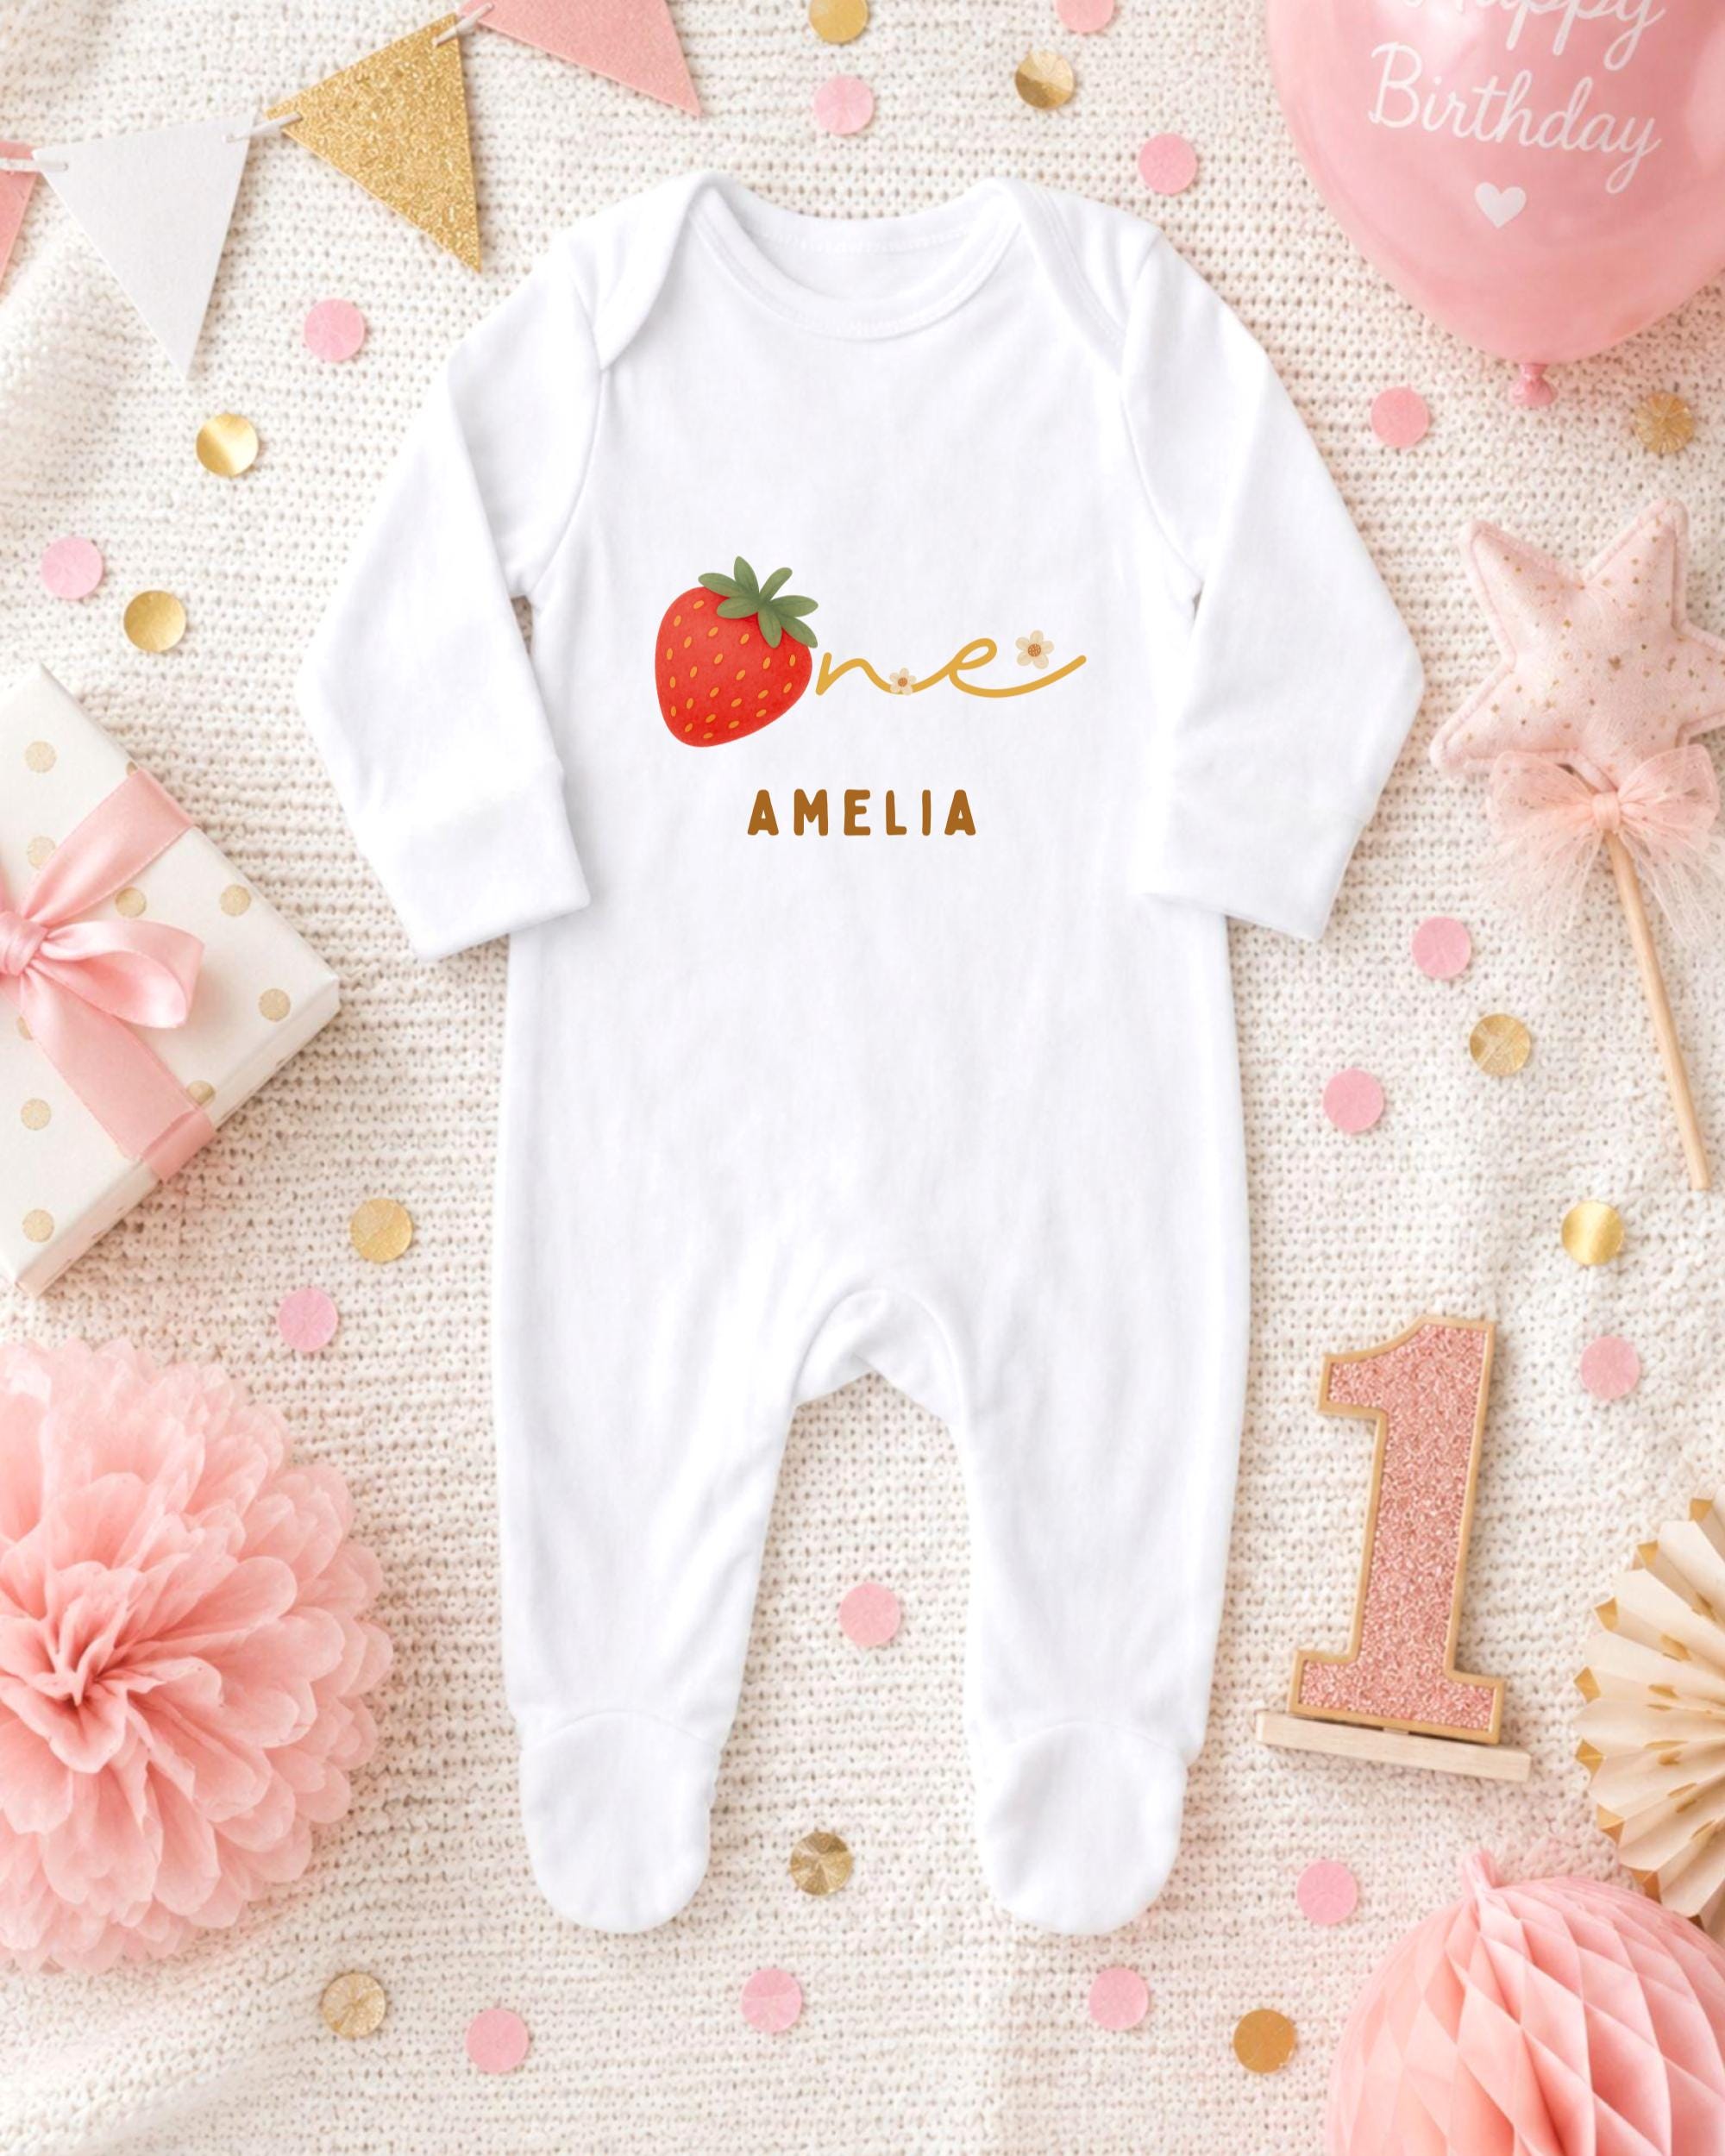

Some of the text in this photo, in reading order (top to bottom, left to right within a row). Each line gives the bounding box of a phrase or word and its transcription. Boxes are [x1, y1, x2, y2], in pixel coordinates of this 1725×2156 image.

[1402, 0, 1666, 71] ppy
[1369, 41, 1662, 194] Birthday
[747, 789, 976, 837] AMELIA
[1289, 1314, 1505, 1744] 1
